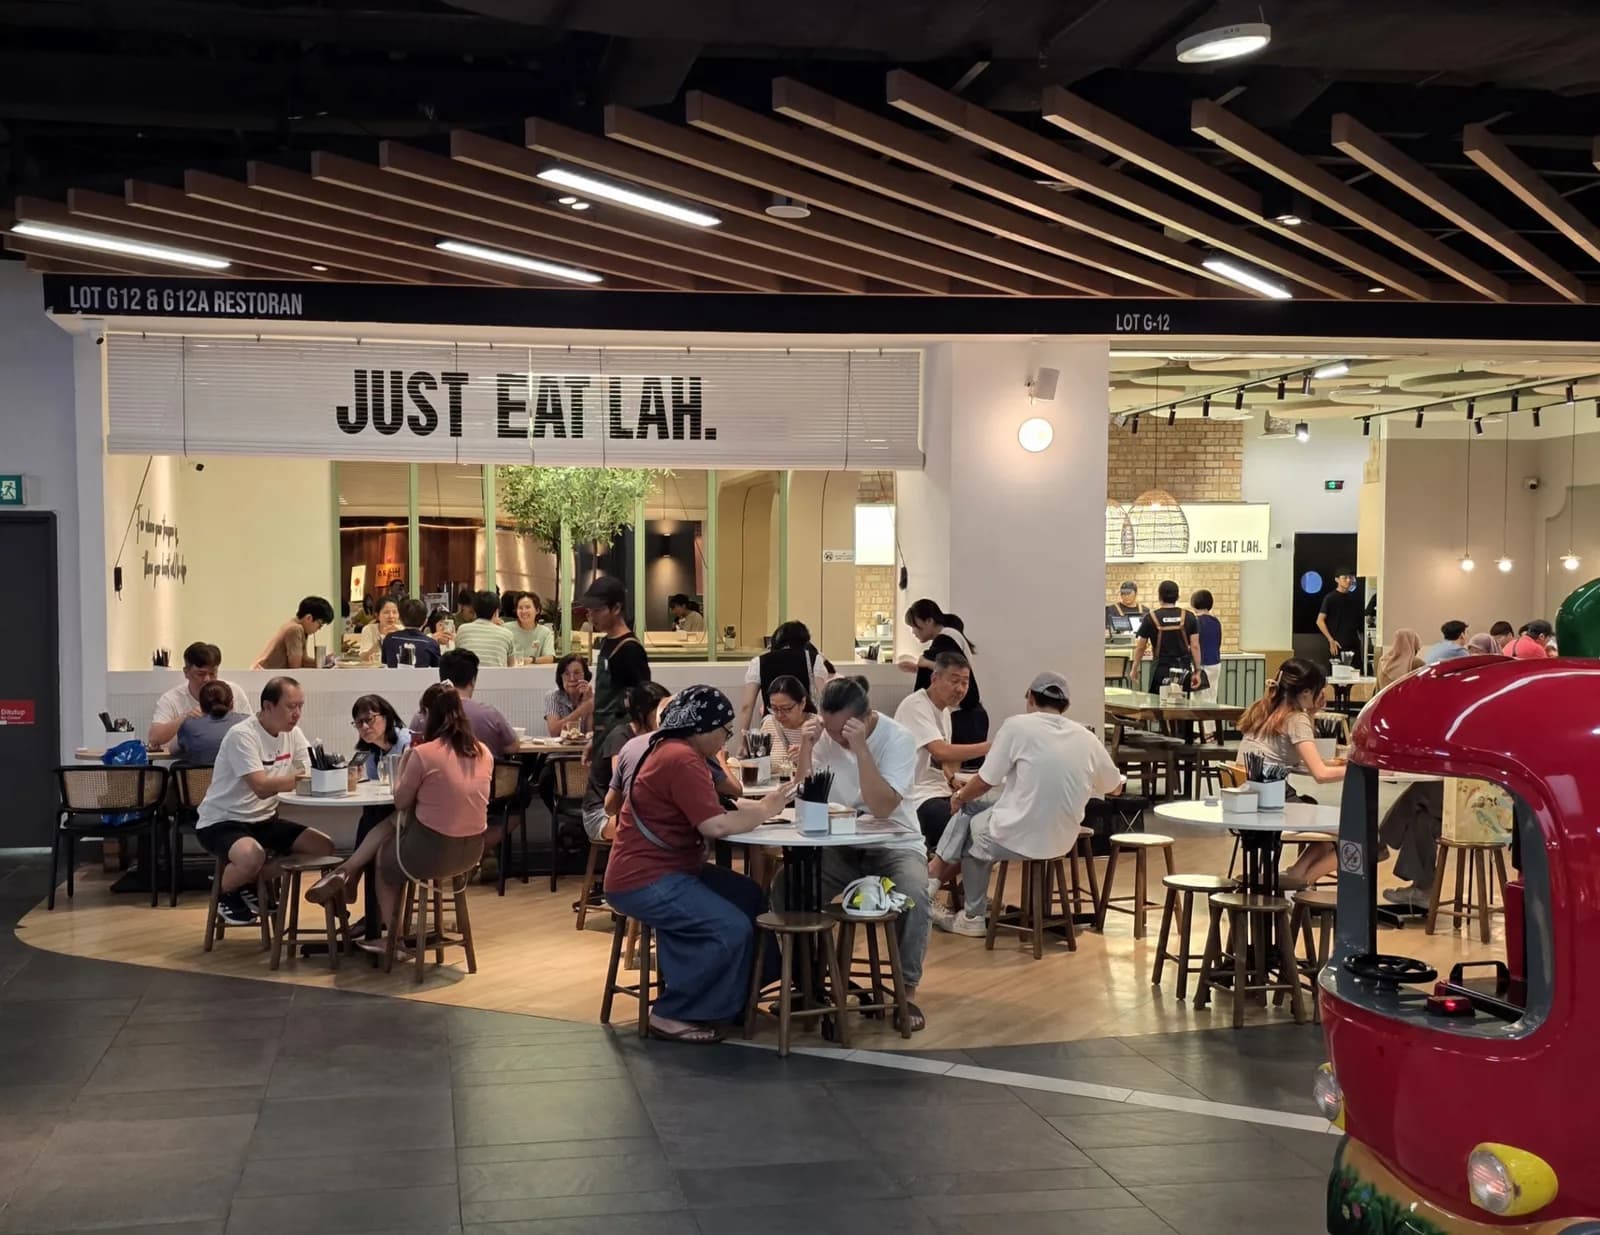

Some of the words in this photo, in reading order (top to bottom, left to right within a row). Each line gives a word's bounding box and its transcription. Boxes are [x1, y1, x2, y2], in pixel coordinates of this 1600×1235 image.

[69, 286, 101, 309] LOT
[106, 287, 141, 311] G12
[146, 289, 158, 311] &
[163, 289, 209, 313] G12A
[214, 291, 303, 315] RESTORAN
[1116, 313, 1140, 331] LOT
[1143, 313, 1170, 331] G-12
[336, 369, 469, 437] JUST
[496, 373, 591, 439] EAT
[608, 376, 717, 440] LAH.
[1193, 540, 1218, 554] JUST
[1221, 540, 1238, 554] EAT
[1241, 540, 1262, 553] LAH.
